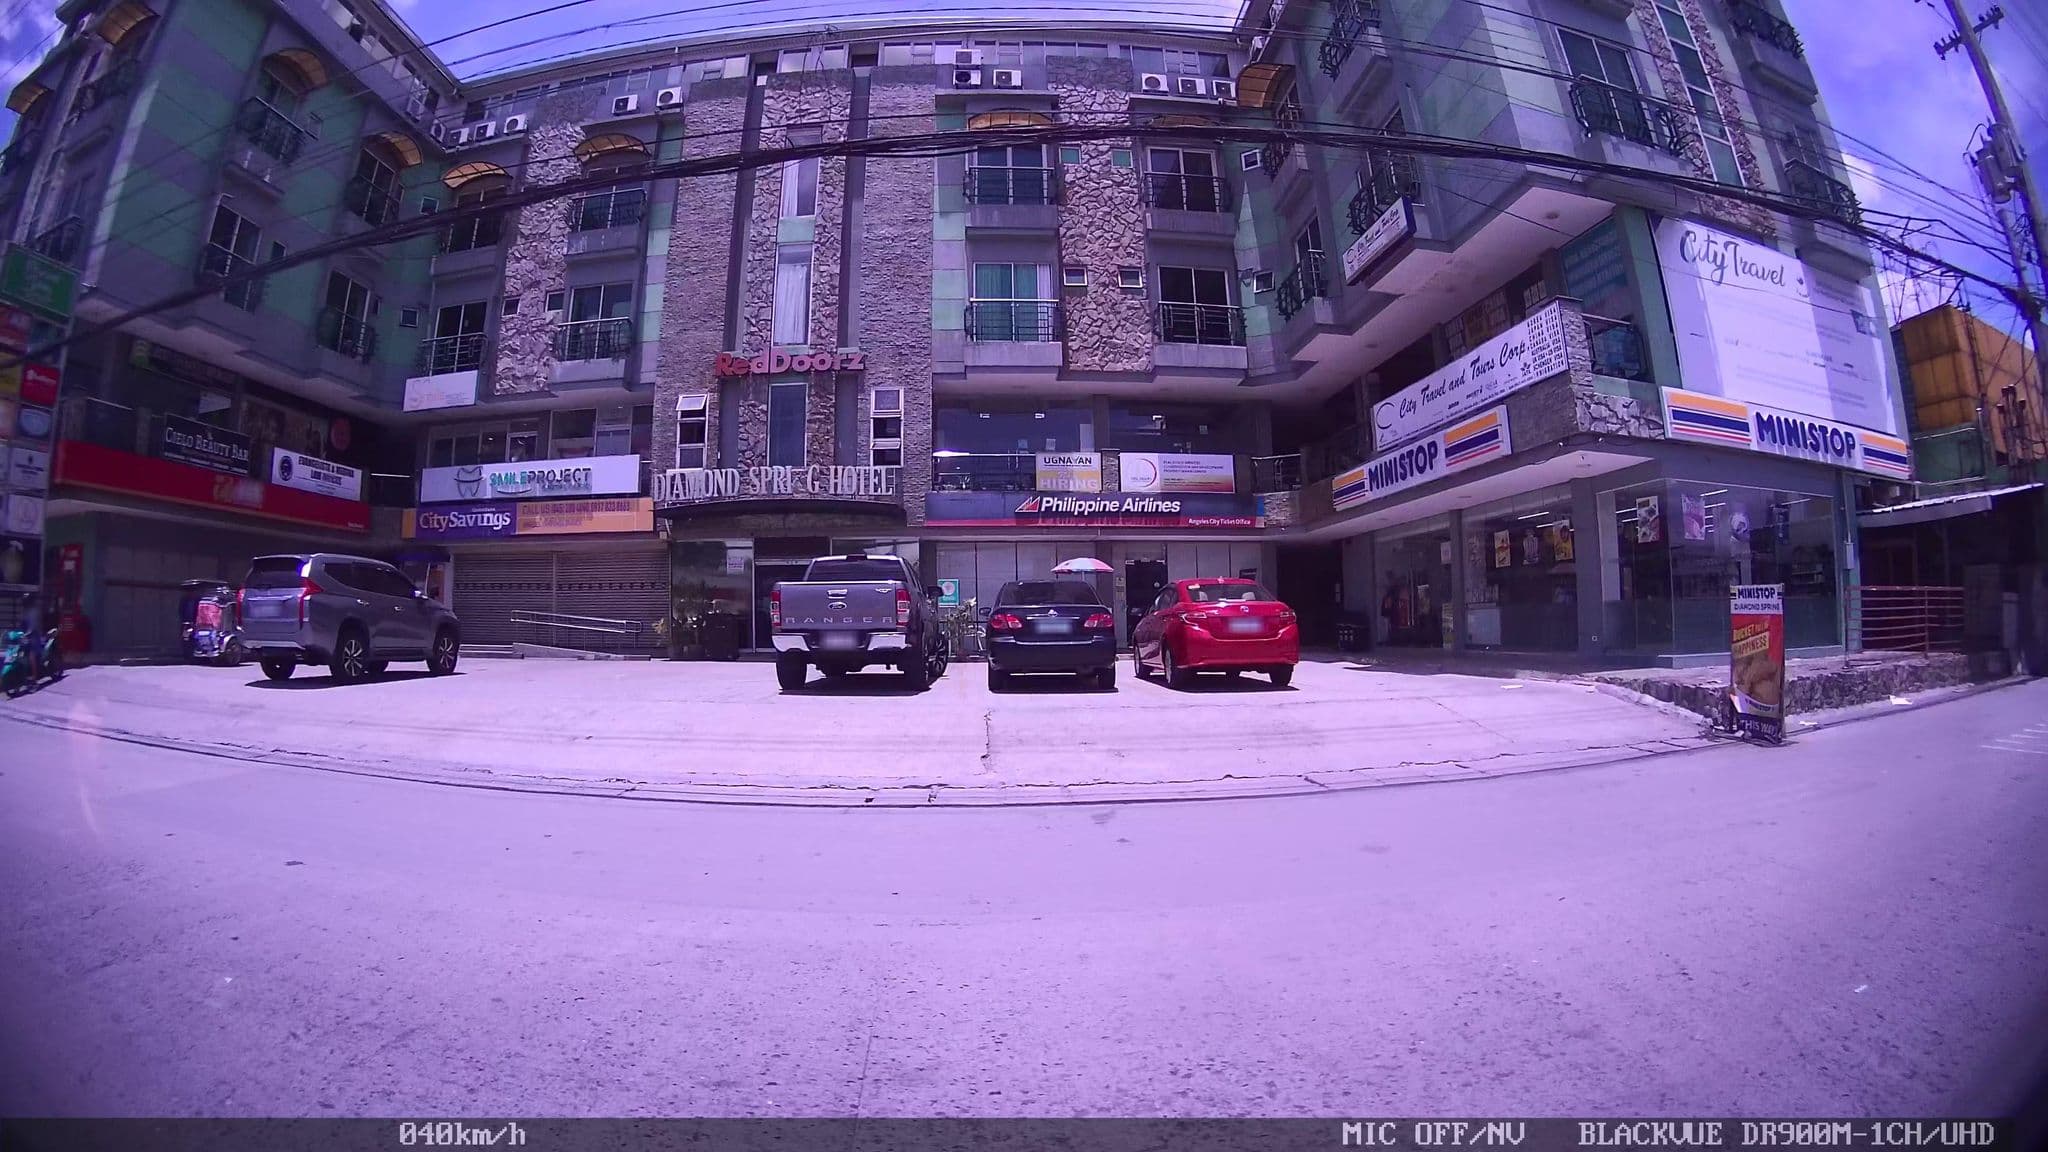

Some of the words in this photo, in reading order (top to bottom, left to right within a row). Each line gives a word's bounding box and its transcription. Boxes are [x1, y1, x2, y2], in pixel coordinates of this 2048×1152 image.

[1679, 230, 1728, 285] City
[1723, 240, 1785, 287] Travel
[715, 349, 867, 376] RedDoorz
[1400, 398, 1417, 419] City
[1421, 379, 1446, 406] Travel
[1450, 369, 1465, 392] and
[1470, 355, 1495, 381] Tours
[1755, 411, 1856, 458] MINISTOP
[1043, 455, 1092, 465] UGNAYAN
[1367, 440, 1438, 491] MINISTOP
[653, 467, 741, 501] DIAMOND
[829, 465, 894, 495] HOTEL
[1040, 478, 1098, 490] HIRING
[1040, 496, 1120, 516] Philippine
[1121, 496, 1181, 513] Airlines
[1734, 603, 1760, 611] DIAMOND
[1736, 587, 1776, 600] MINISTOP
